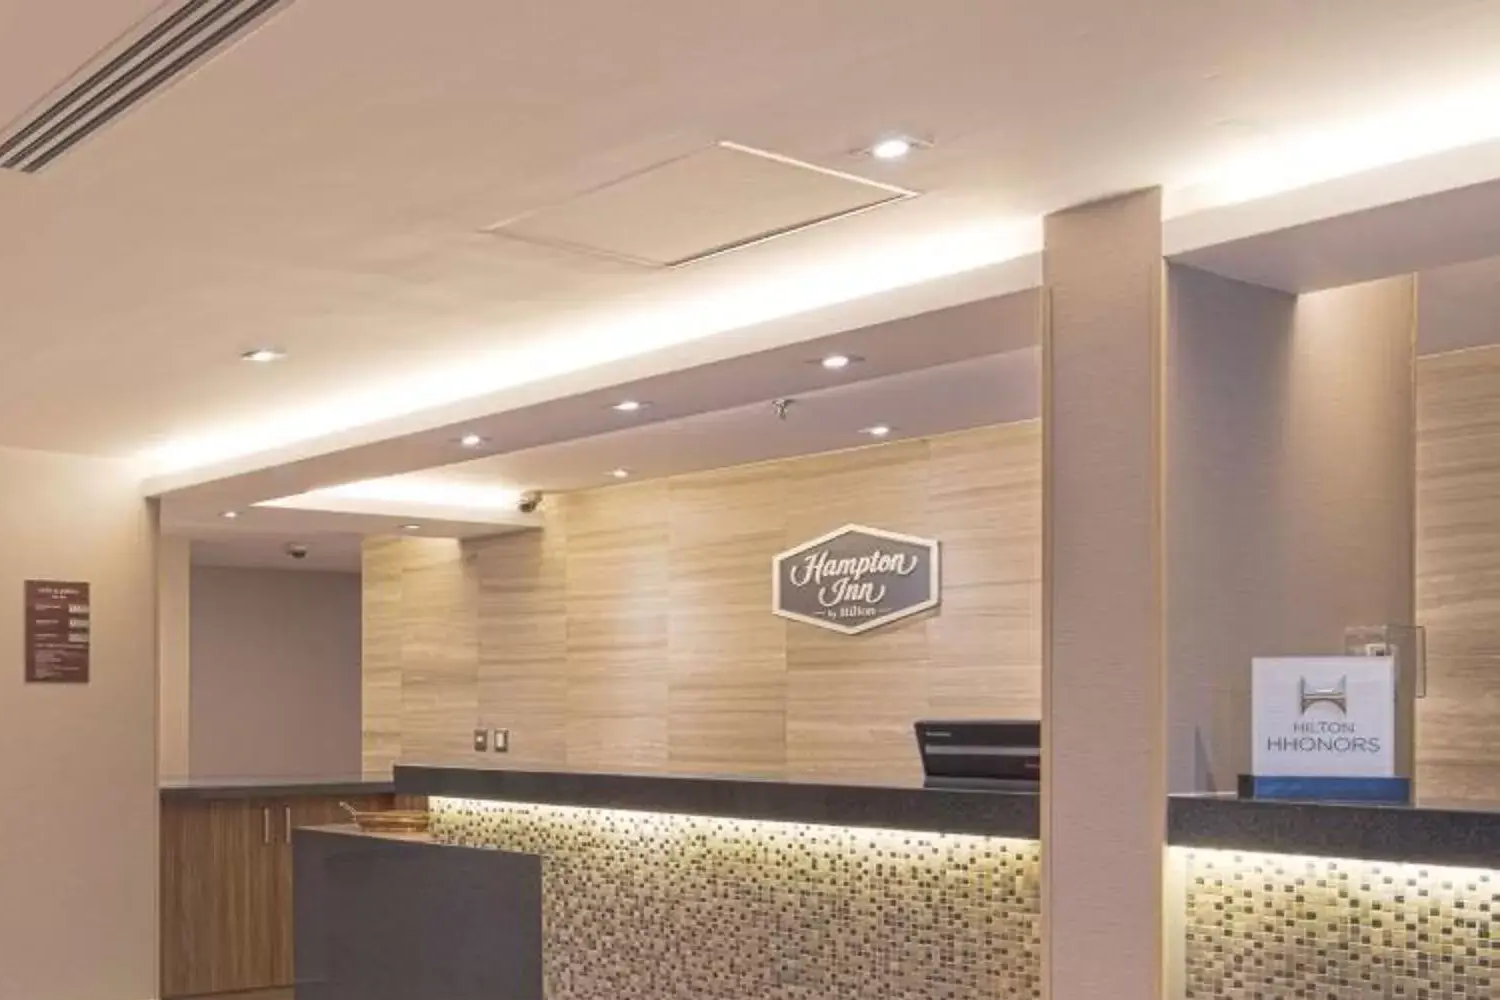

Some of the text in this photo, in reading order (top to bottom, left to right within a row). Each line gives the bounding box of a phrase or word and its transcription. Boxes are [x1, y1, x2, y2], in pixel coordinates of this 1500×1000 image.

[790, 549, 918, 587] Hampton
[818, 577, 887, 607] Inn
[1293, 720, 1355, 734] HILTON
[1266, 735, 1381, 753] HHONORS
